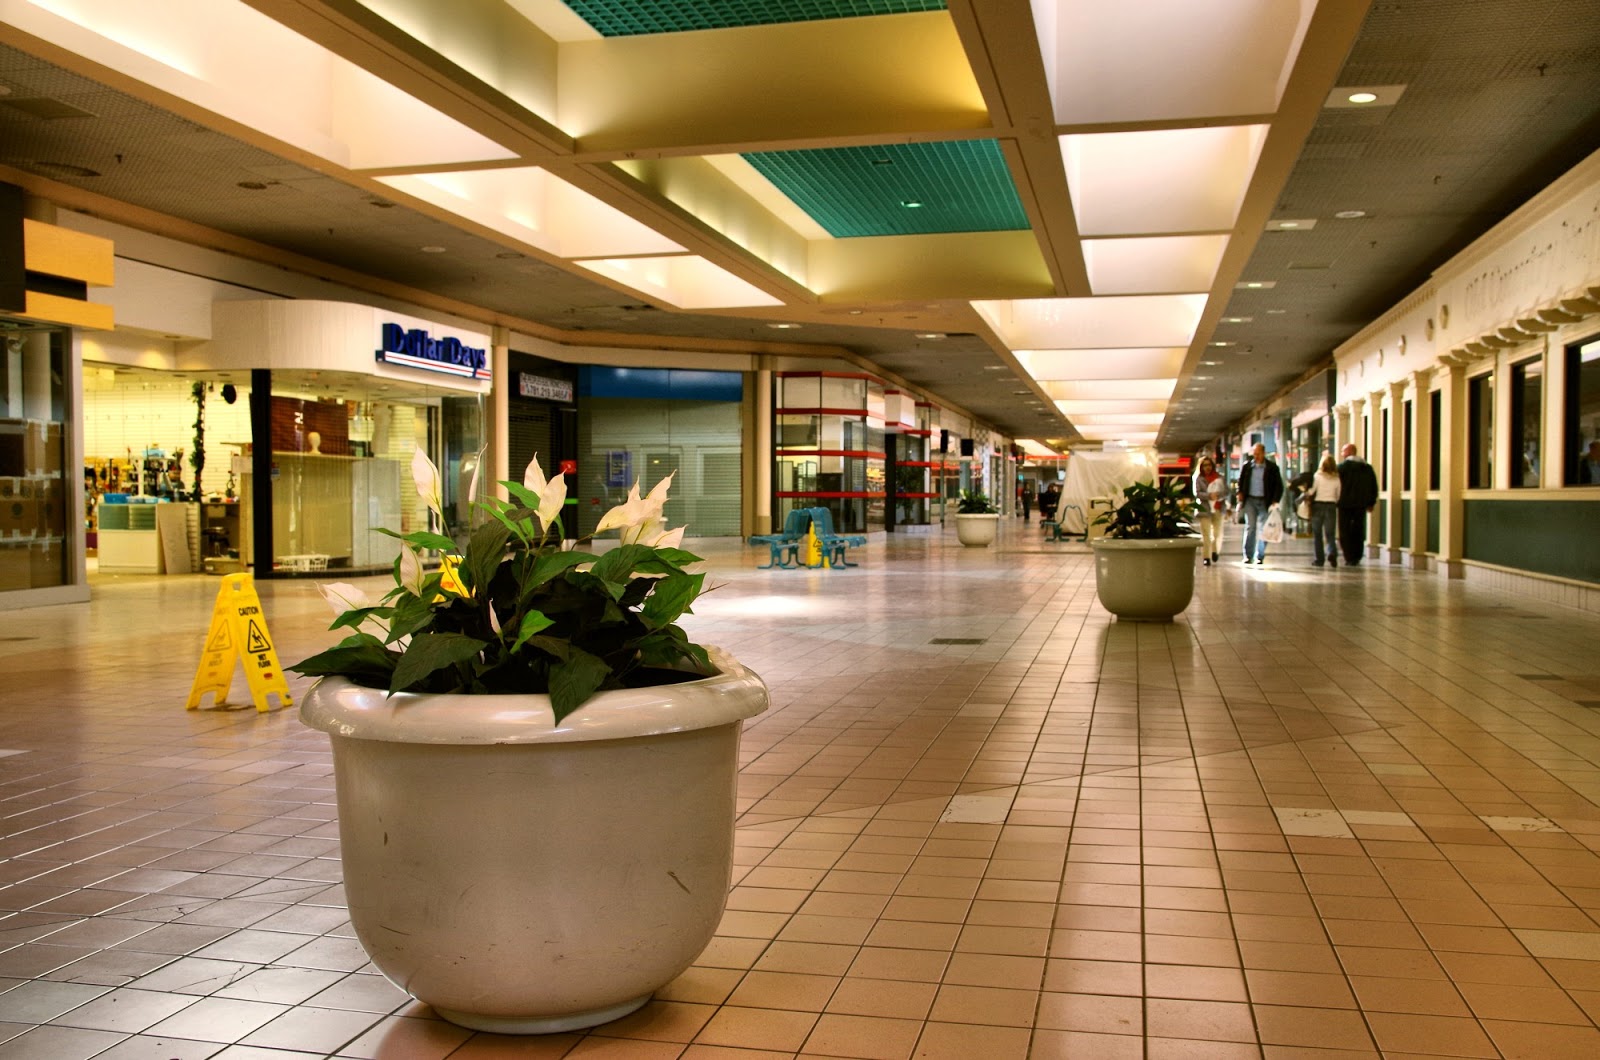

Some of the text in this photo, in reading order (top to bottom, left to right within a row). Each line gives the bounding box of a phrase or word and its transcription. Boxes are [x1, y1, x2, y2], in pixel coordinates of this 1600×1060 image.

[383, 323, 486, 376] Dollar Days
[238, 606, 259, 616] CAUTION
